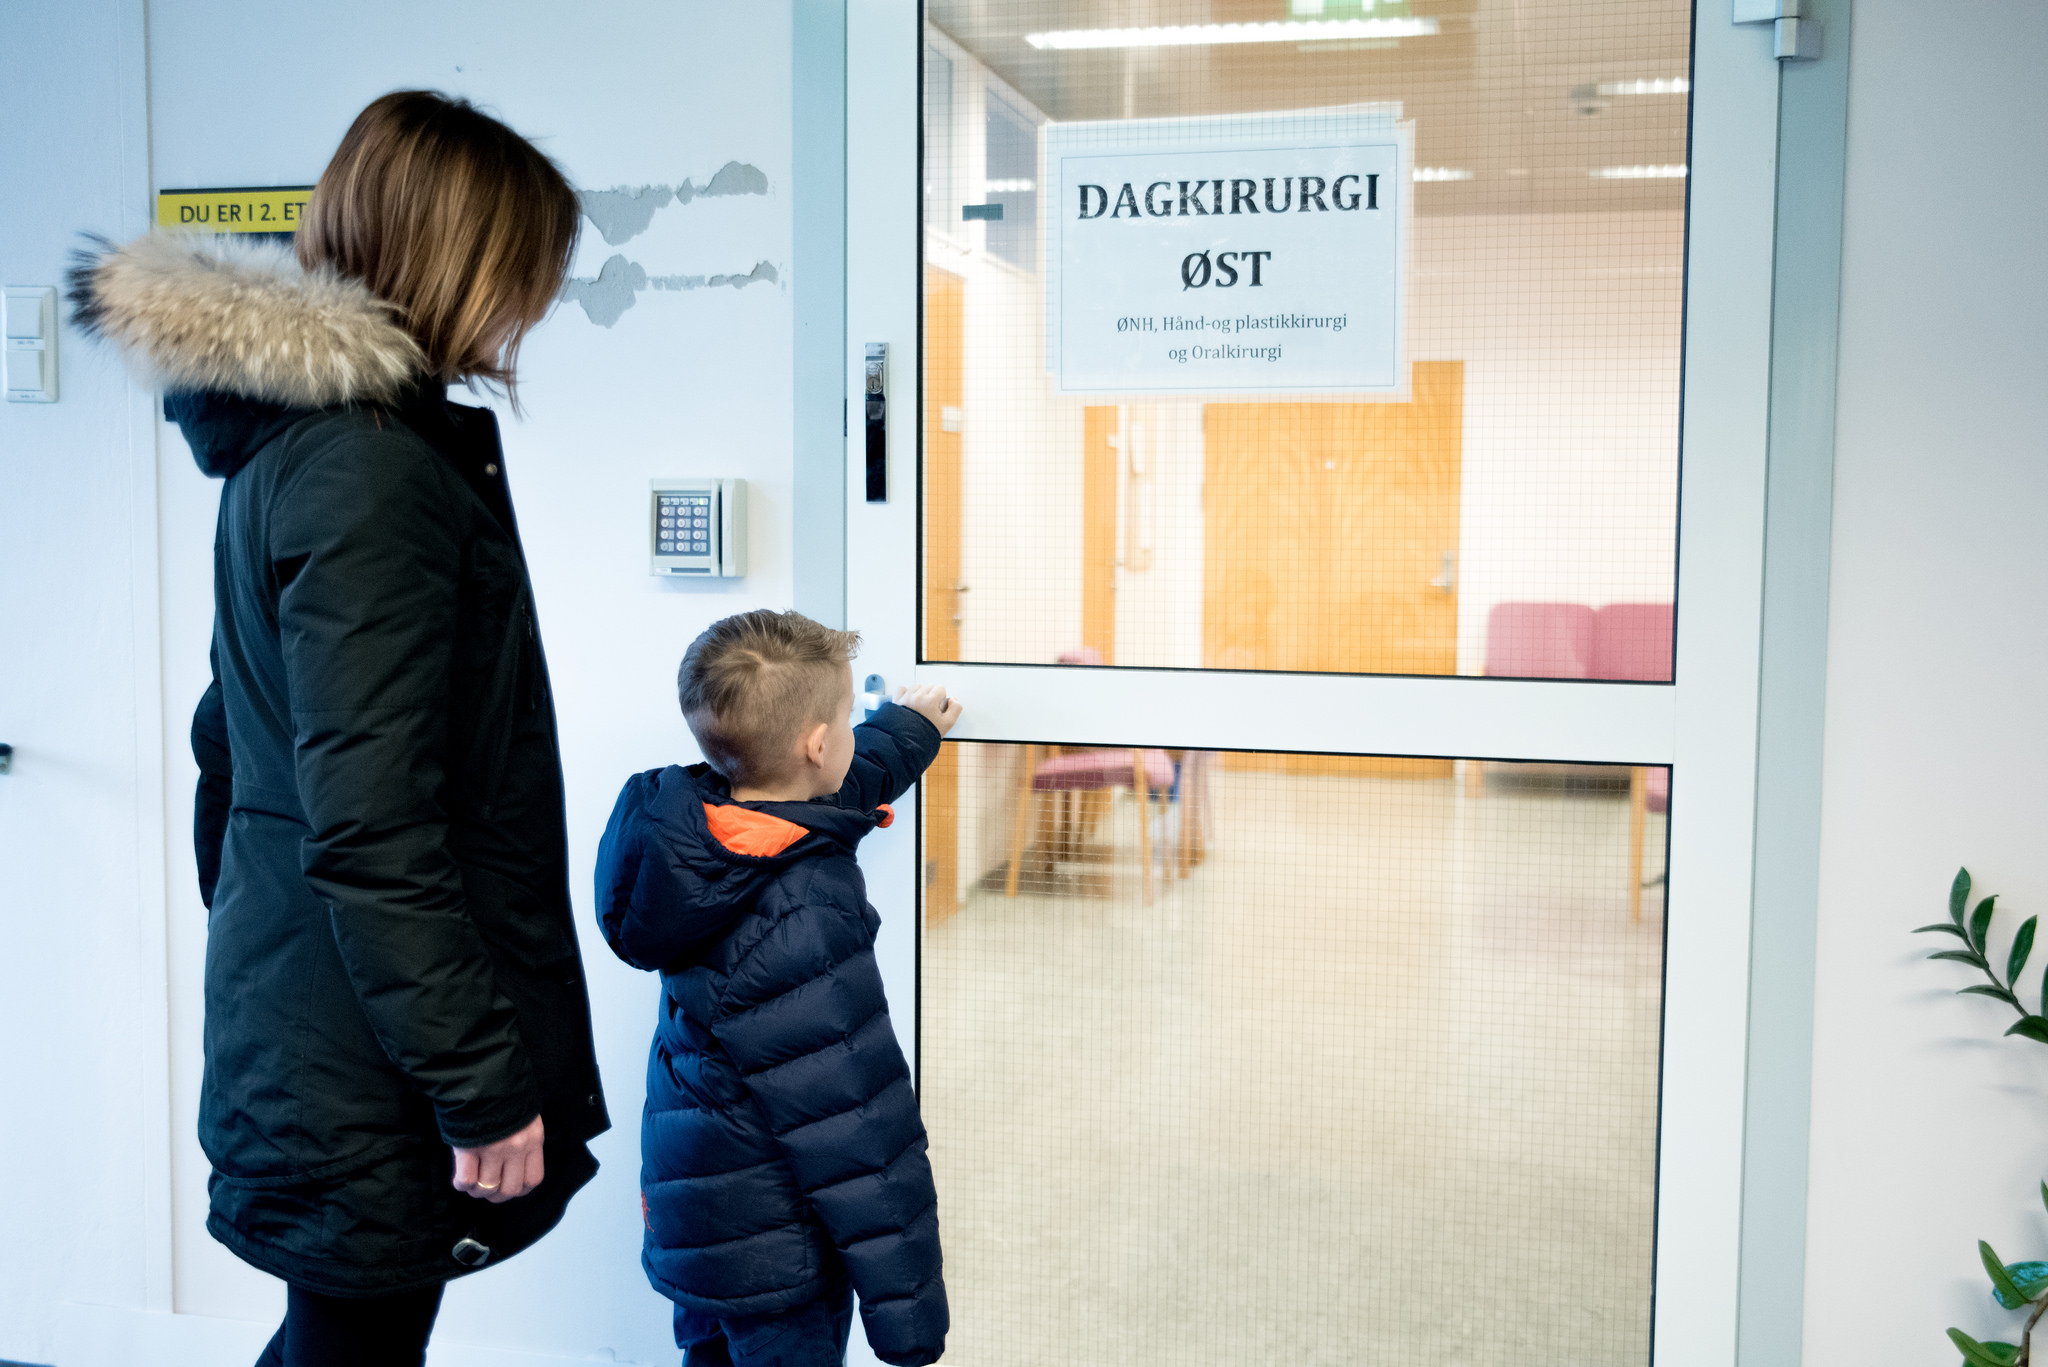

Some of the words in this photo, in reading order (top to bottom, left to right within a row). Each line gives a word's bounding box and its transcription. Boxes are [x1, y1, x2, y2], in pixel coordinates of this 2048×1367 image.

[1078, 174, 1381, 220] DAGKIRURGI
[181, 205, 210, 224] DU
[217, 204, 242, 223] ER
[260, 203, 277, 222] 2.
[1181, 249, 1272, 292] ØST
[1117, 316, 1158, 334] ØNH,
[1163, 315, 1232, 334] Hånd-og
[1236, 312, 1347, 334] plastikkirurgi
[1169, 349, 1188, 364] og
[1192, 343, 1282, 363] Oralkirurgi
